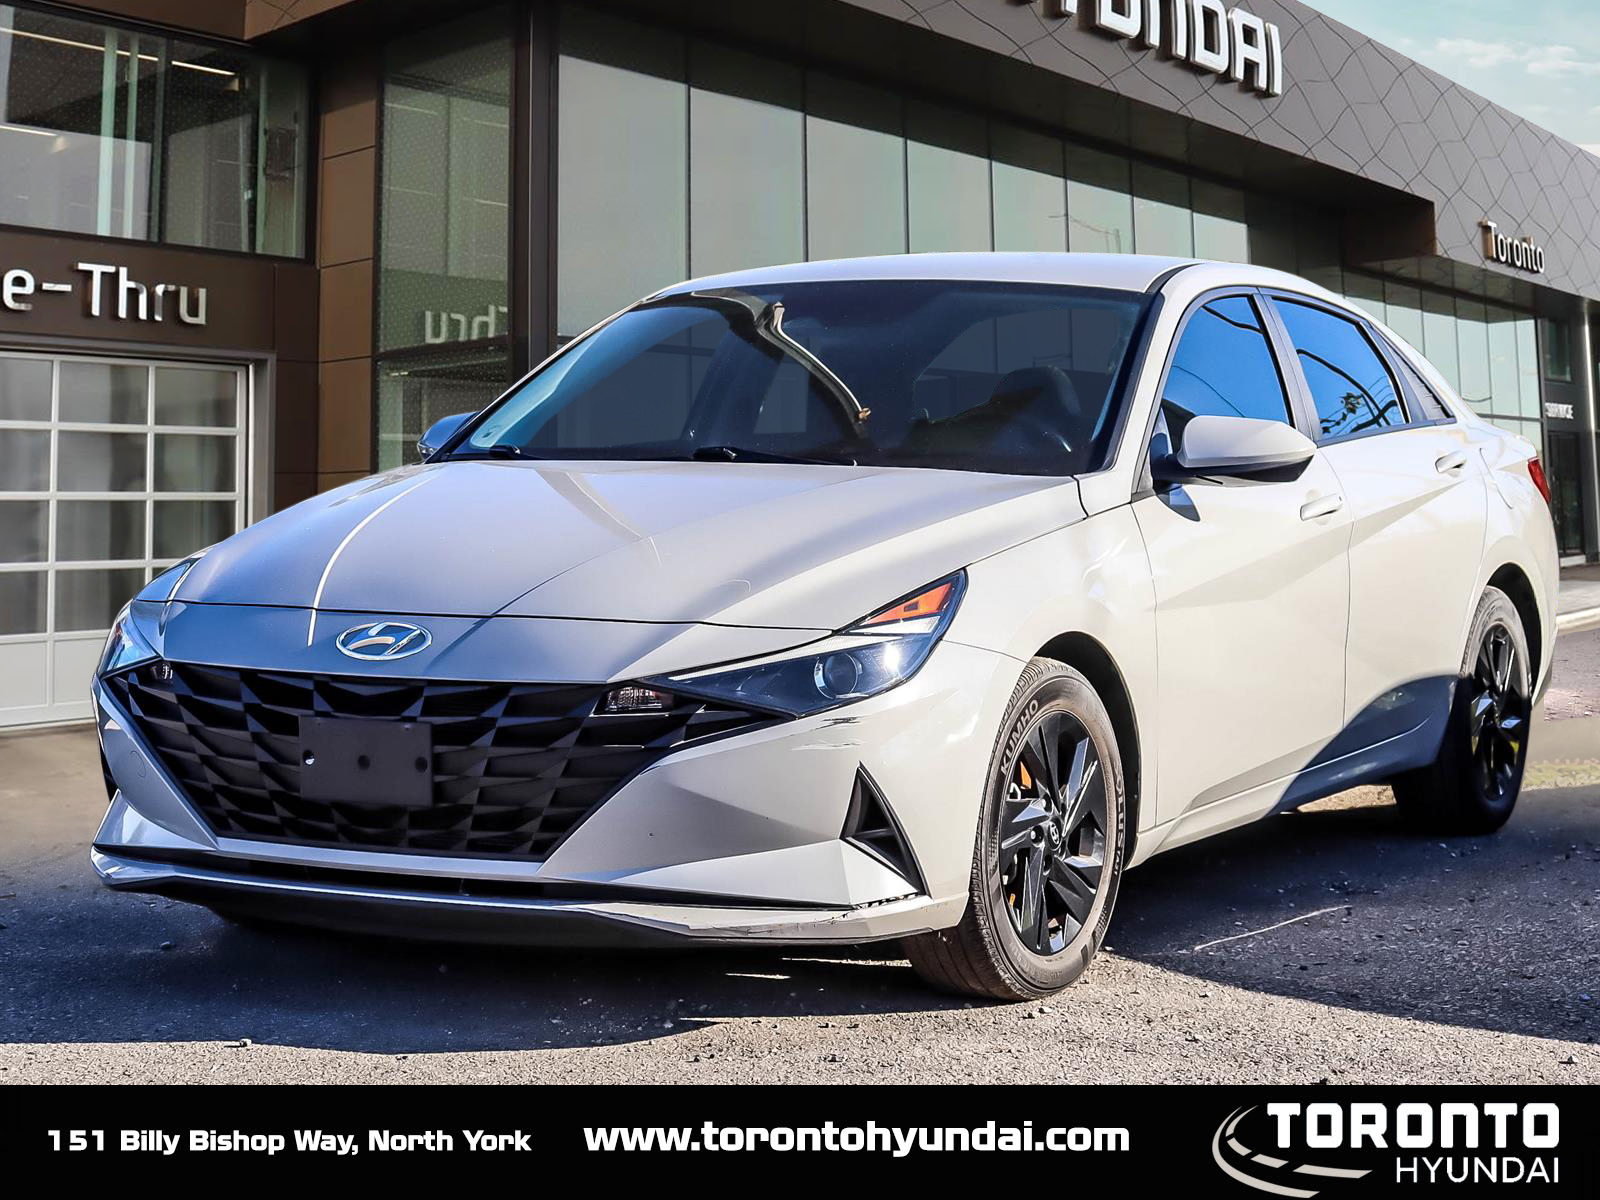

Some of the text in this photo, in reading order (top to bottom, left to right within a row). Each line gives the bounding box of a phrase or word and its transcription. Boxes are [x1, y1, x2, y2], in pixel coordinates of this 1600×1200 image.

[1060, 0, 1283, 97] NDAI
[1485, 219, 1545, 273] Toronto
[3, 262, 207, 325] e-Thru
[1000, 699, 1038, 776] KUMHO
